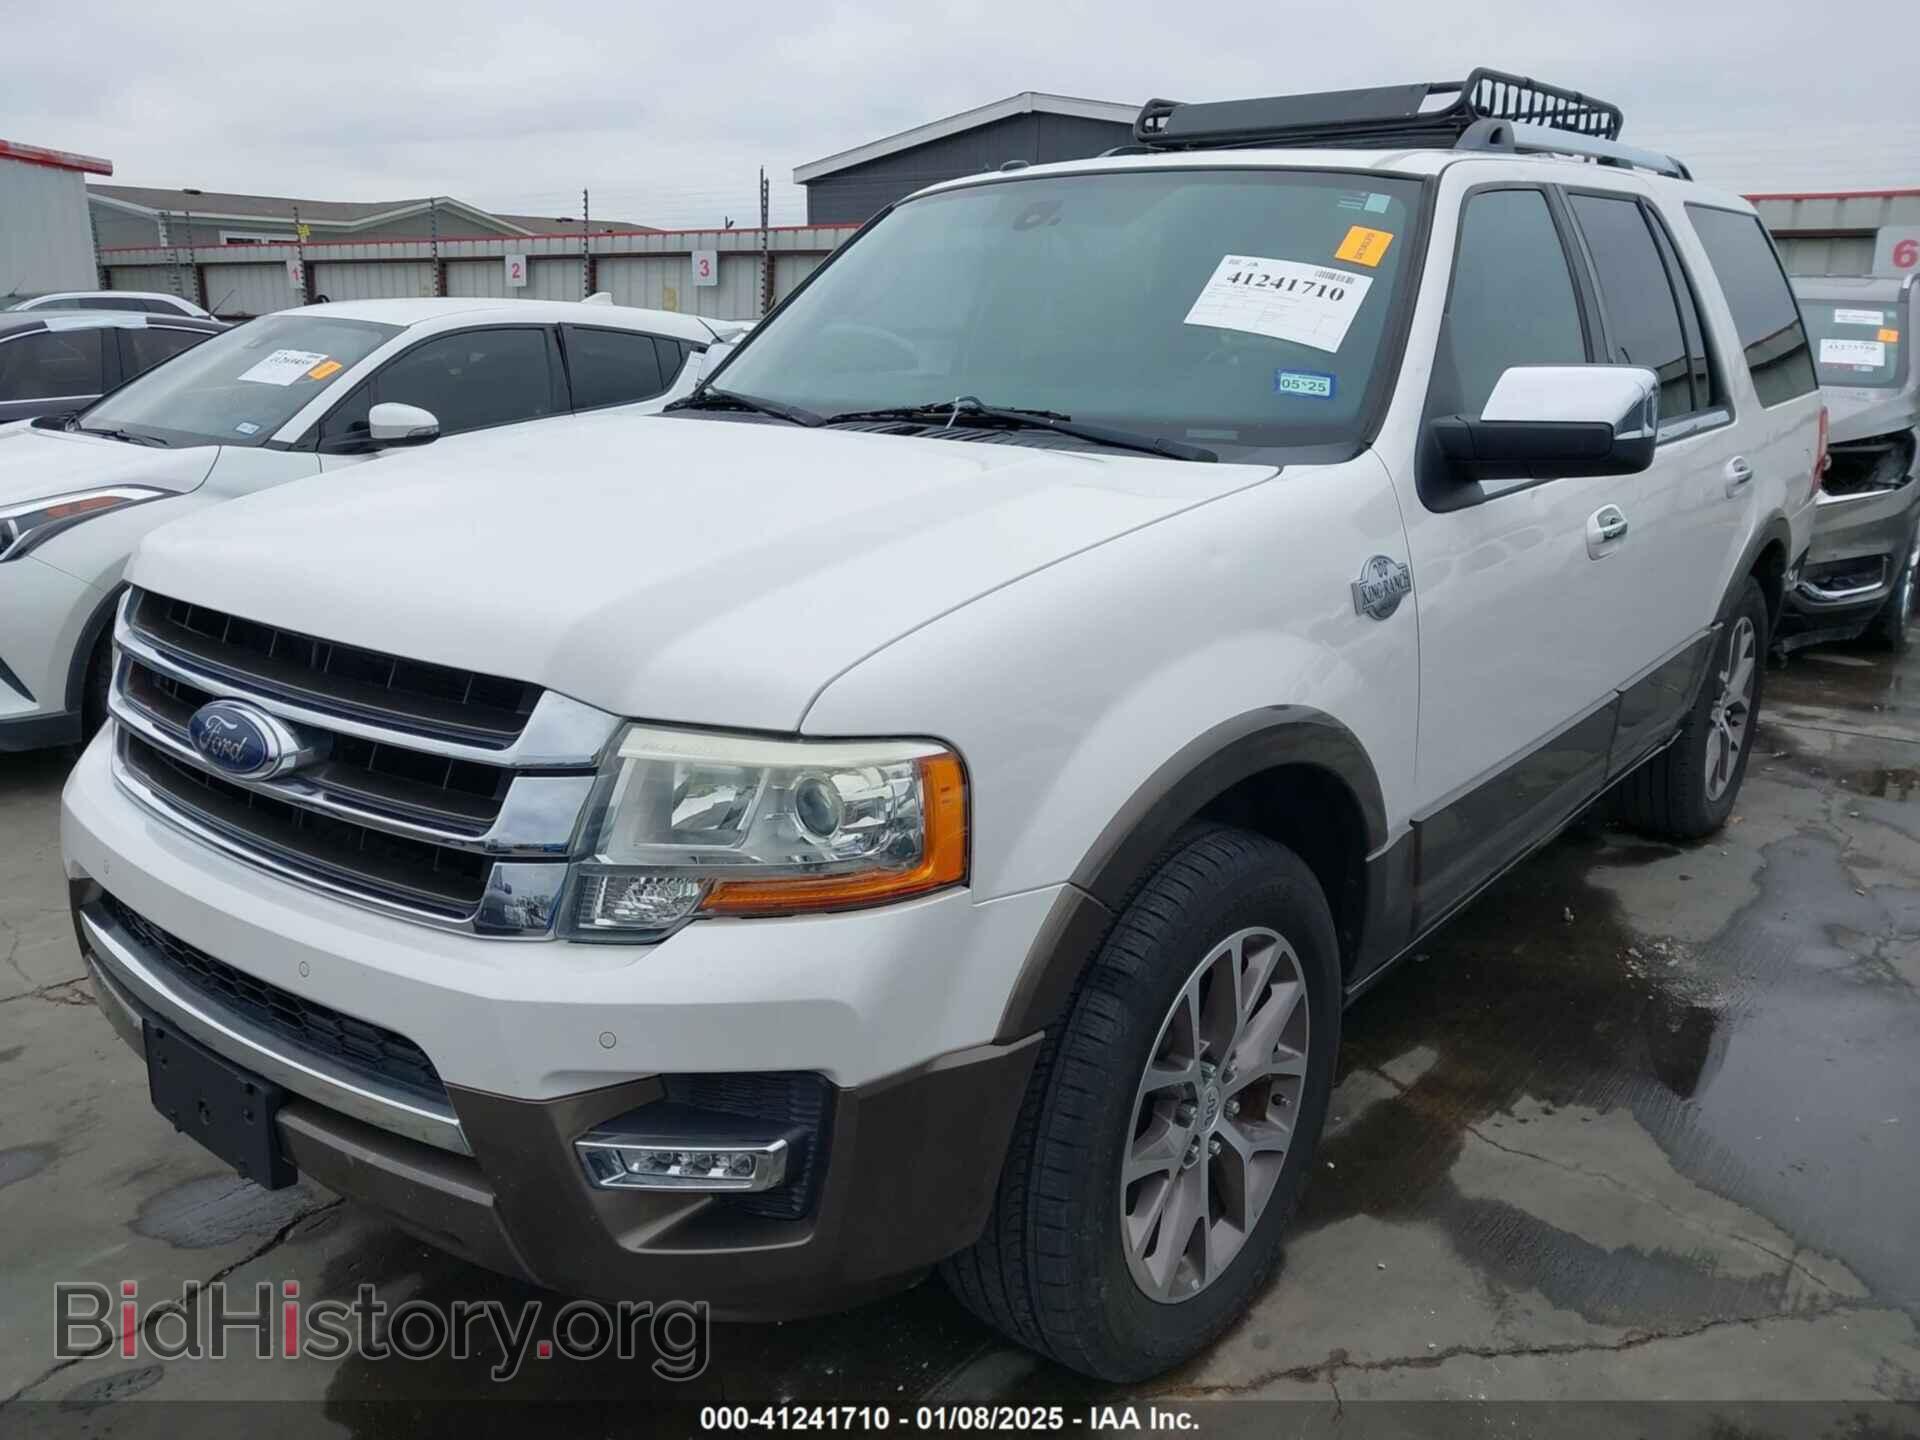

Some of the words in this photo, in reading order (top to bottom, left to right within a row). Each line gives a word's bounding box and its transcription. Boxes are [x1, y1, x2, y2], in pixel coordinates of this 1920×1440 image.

[1893, 239, 1920, 268] 6
[511, 263, 521, 279] 2
[699, 259, 710, 277] 3
[1227, 271, 1345, 301] 41241710
[1281, 378, 1300, 389] 05
[1308, 381, 1326, 392] 25
[200, 715, 248, 762] Ford
